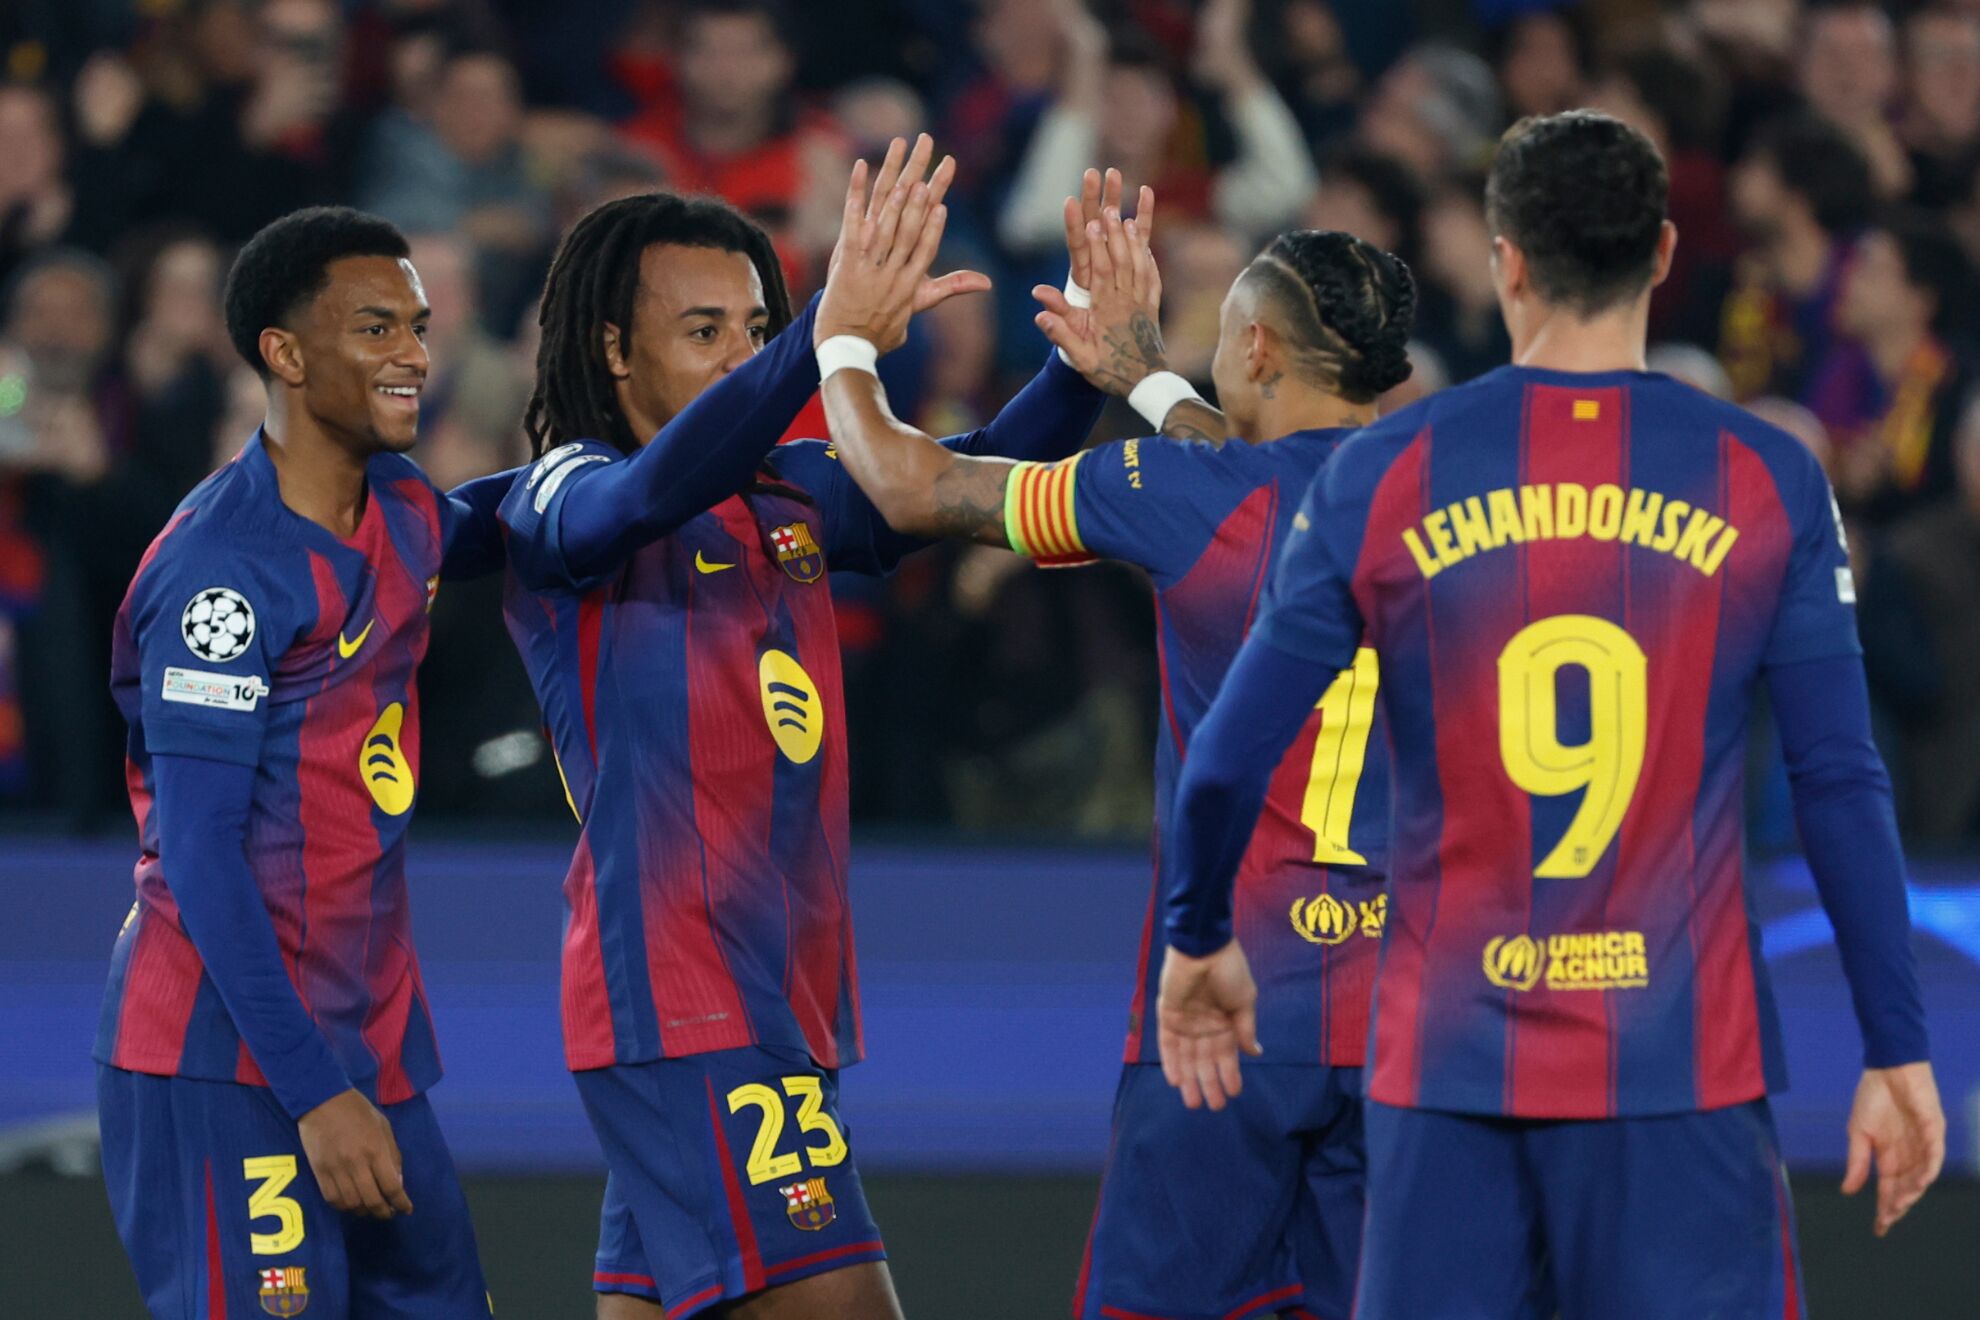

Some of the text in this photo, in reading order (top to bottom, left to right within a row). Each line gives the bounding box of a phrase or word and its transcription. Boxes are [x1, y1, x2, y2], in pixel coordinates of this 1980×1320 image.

[1402, 483, 1739, 579] LEWANDOWSKI
[209, 610, 227, 639] 5
[1498, 614, 1648, 879] 9
[1545, 955, 1649, 980] ACNUR
[1549, 931, 1647, 956] UNHCR
[726, 1075, 849, 1186] 23
[243, 1153, 306, 1256] 3
